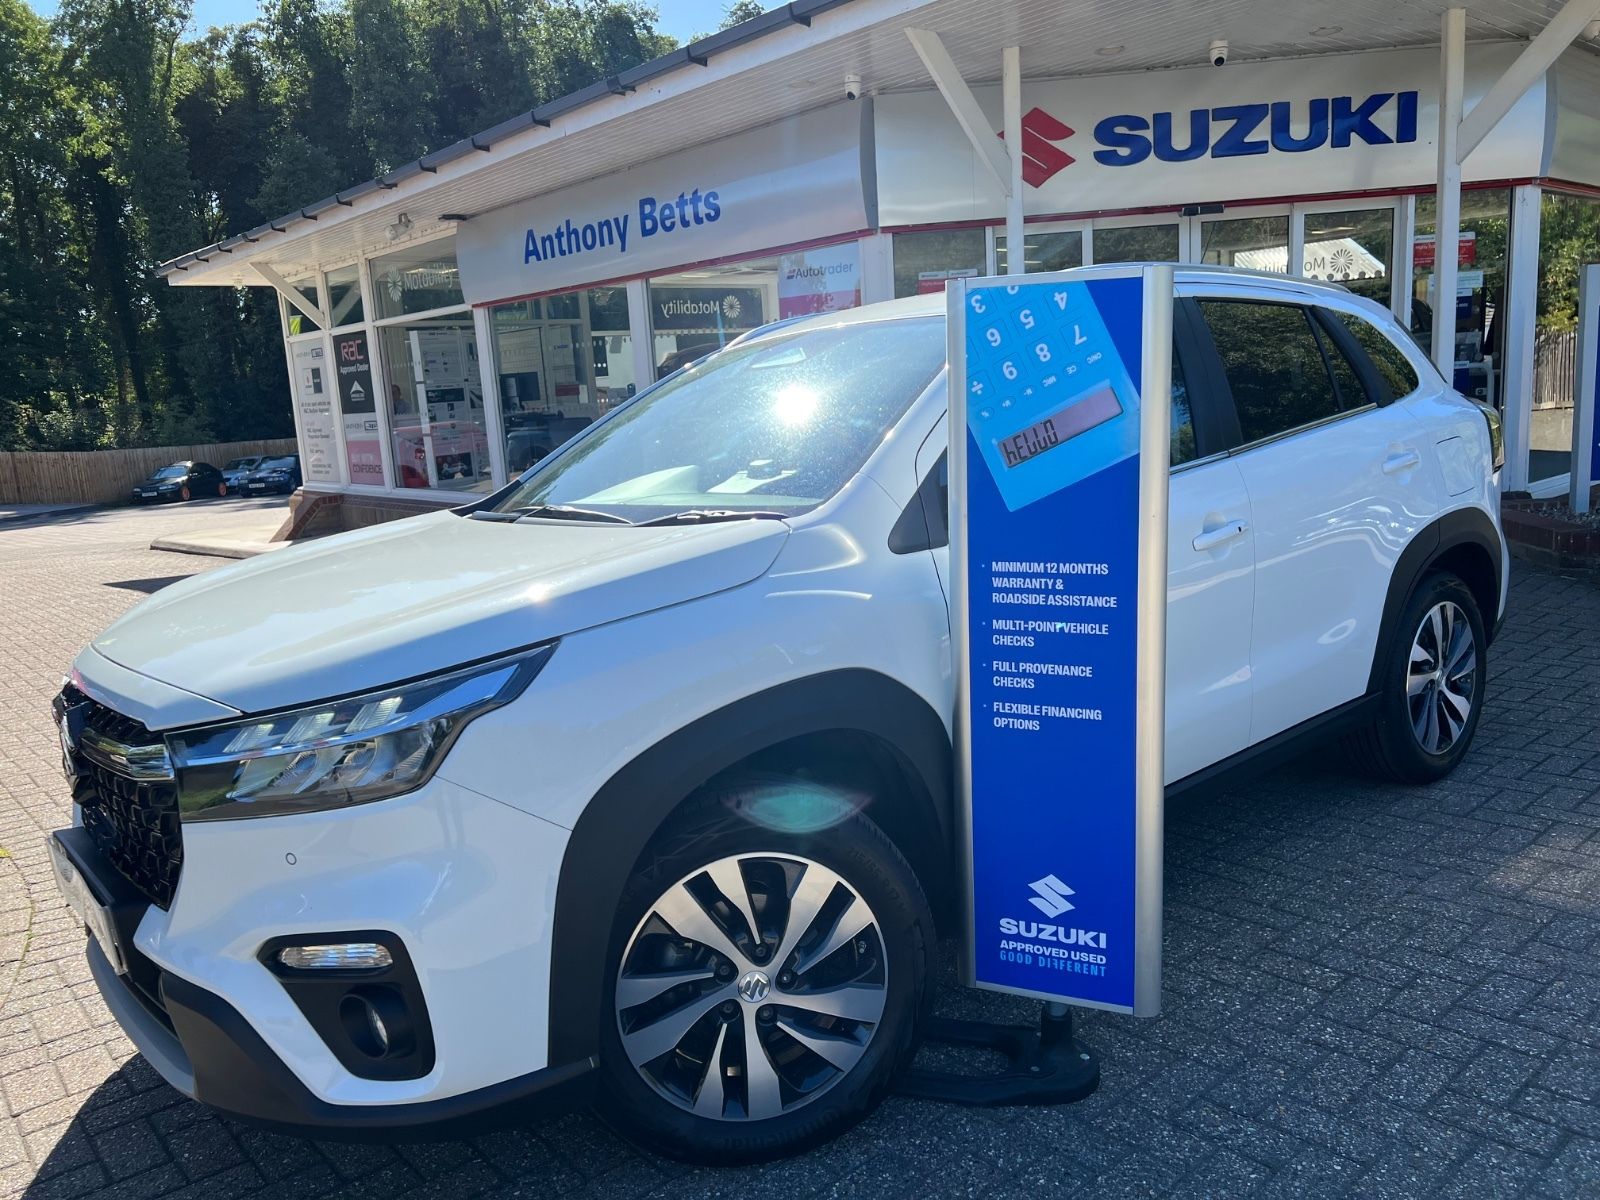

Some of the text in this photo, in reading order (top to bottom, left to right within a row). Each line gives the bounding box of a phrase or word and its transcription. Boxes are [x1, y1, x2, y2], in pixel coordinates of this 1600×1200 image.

[1093, 90, 1418, 167] SUZUKI
[524, 188, 721, 264] Anthony Betts
[795, 262, 854, 280] Autotrader
[971, 294, 986, 313] 3
[1054, 291, 1068, 310] 4
[1019, 309, 1035, 329] 5
[1035, 343, 1051, 362] 8
[992, 561, 1109, 575] MINIMUM 12 MONTHS
[992, 577, 1064, 590] WARRANTY &
[992, 592, 1117, 608] ROADSIDE ASSISTANCE
[992, 619, 1109, 635] MULTI-POINT VEHICLE
[992, 635, 1035, 647] CHECKS
[993, 660, 1093, 678] FULL PROVENANCE
[993, 676, 1035, 689] CHECKS
[993, 702, 1102, 721] FLEXIBLE FINANCING
[993, 717, 1040, 731] OPTIONS
[999, 917, 1107, 949] SUZUKI
[999, 950, 1033, 965] GOOD
[1000, 939, 1107, 965] APPROVED USED
